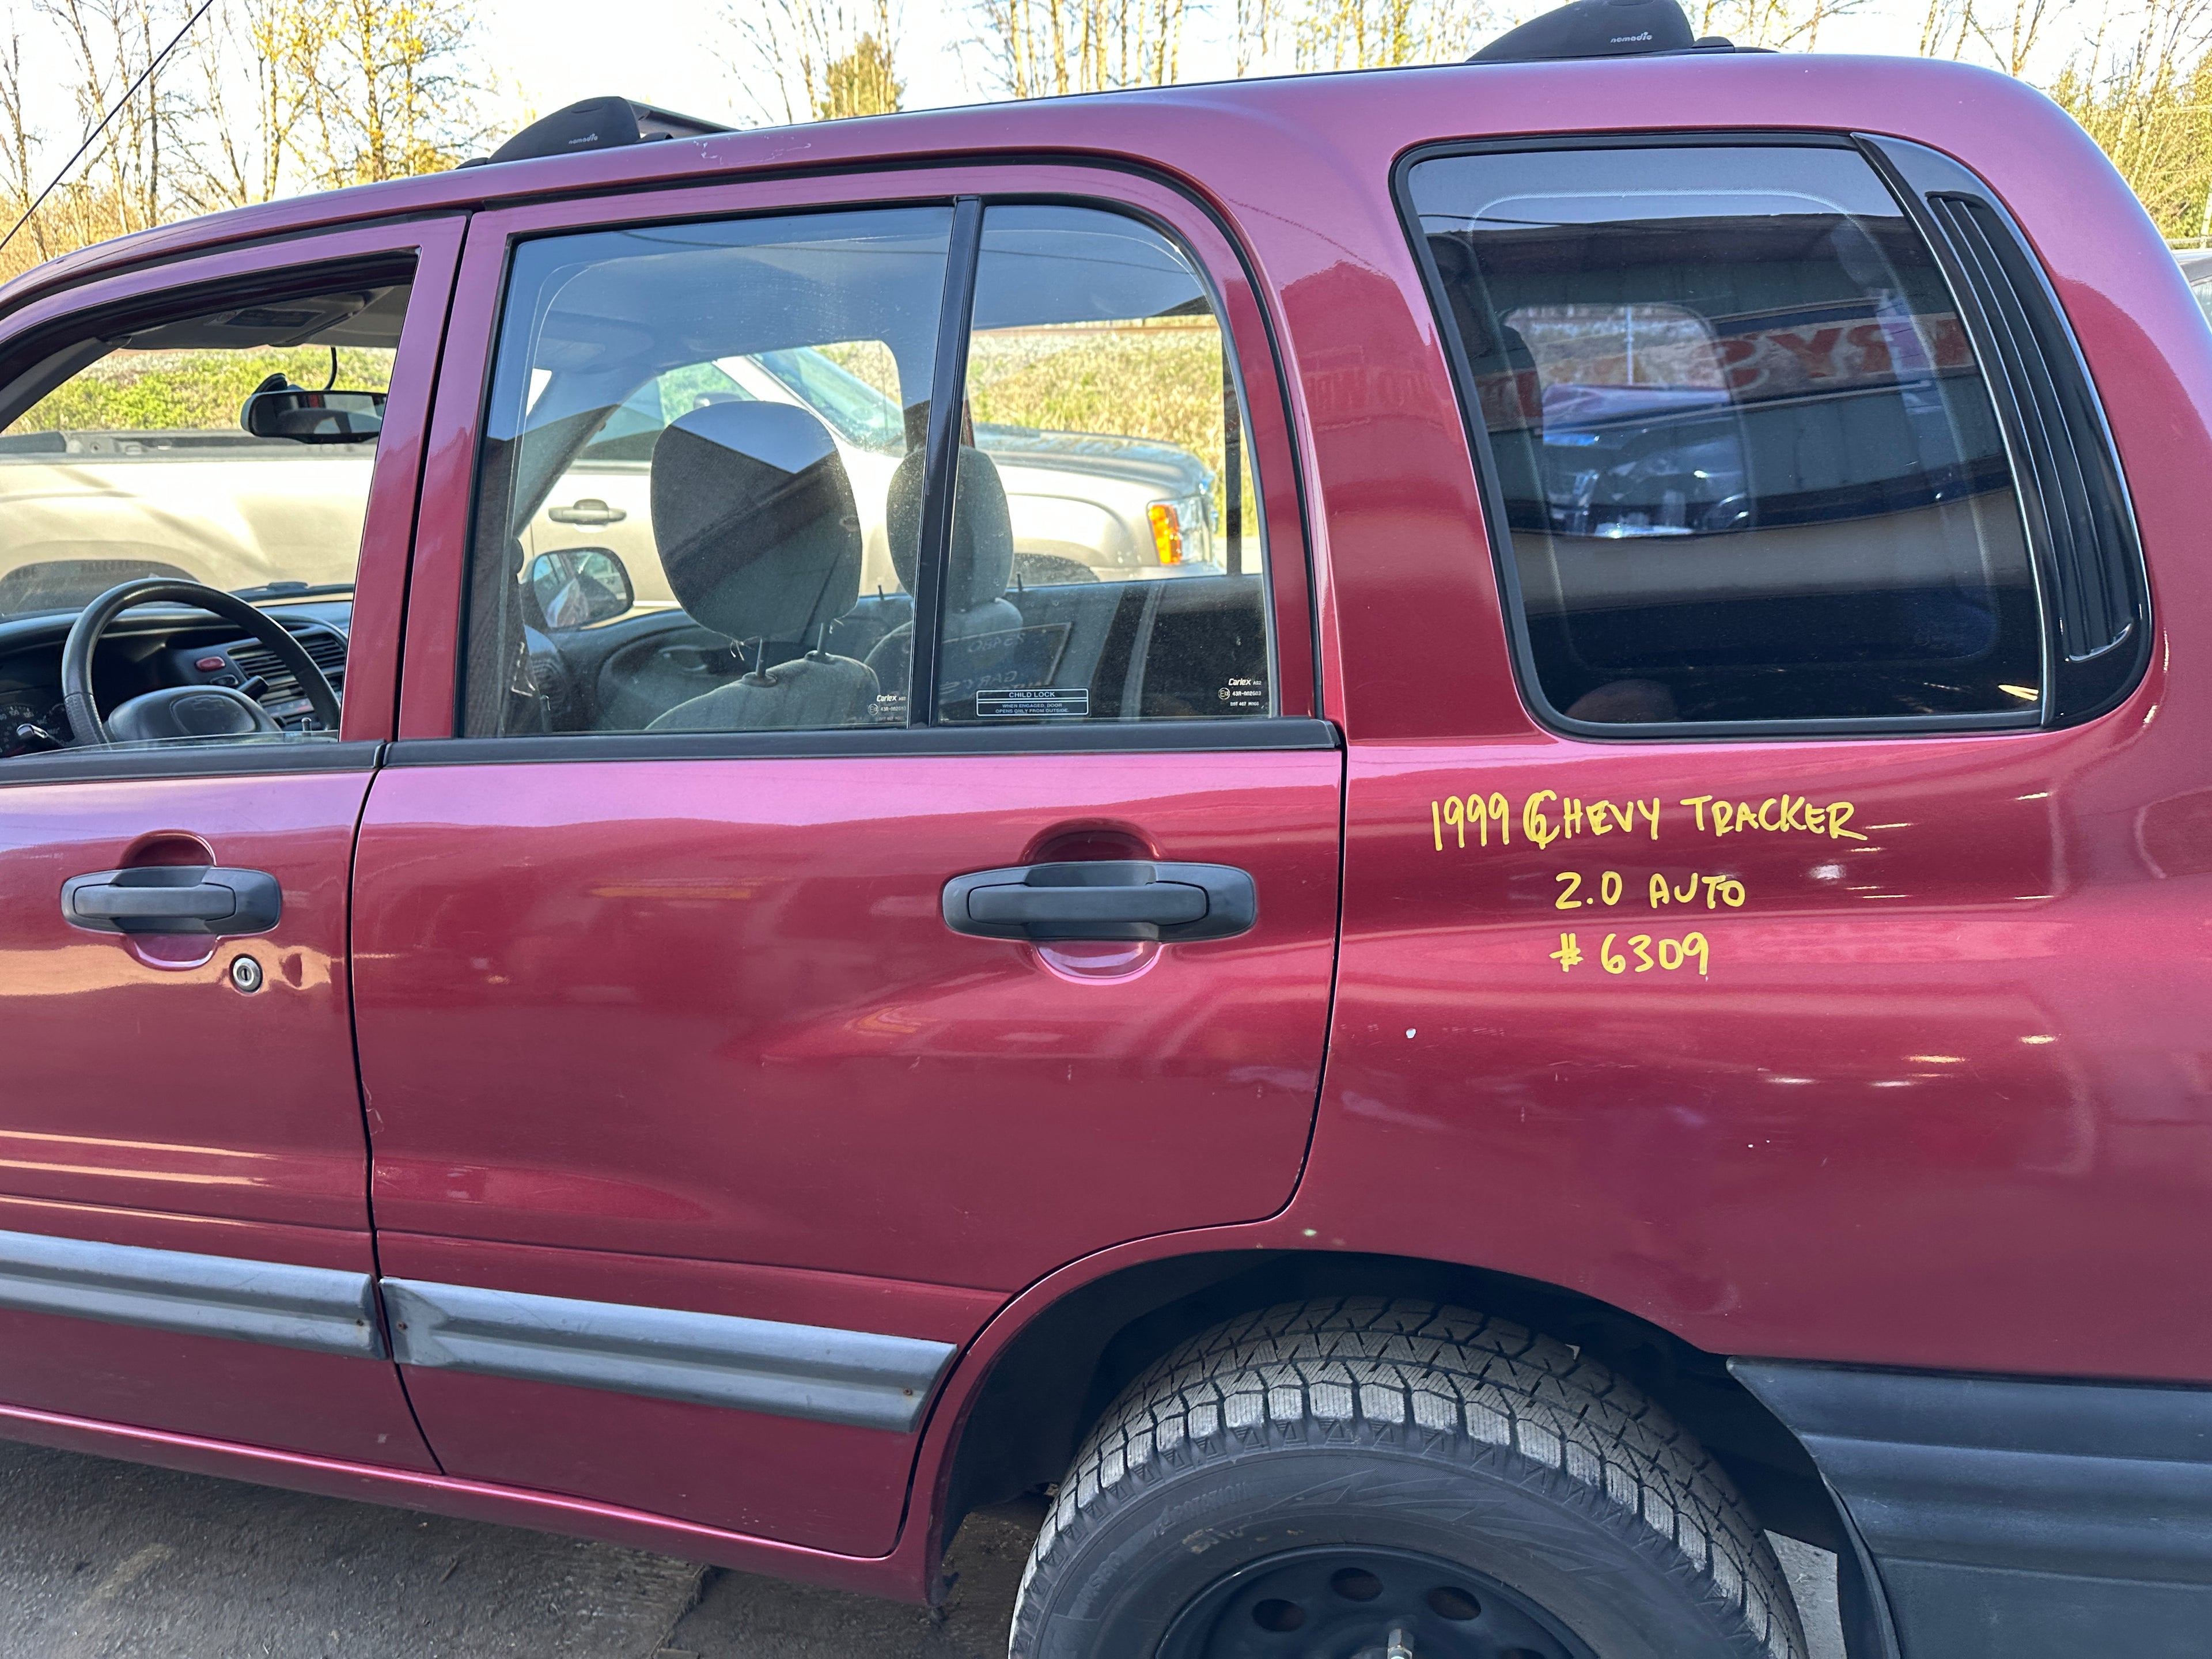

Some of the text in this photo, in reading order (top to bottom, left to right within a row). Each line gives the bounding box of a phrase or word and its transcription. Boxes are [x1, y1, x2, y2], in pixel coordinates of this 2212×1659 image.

[876, 694, 897, 702] Carlex
[1228, 678, 1251, 686] Carlex
[1431, 792, 1510, 851] 1999
[1680, 794, 1868, 840] TRACKER
[1555, 871, 1745, 910] 2.0 AUTO
[1550, 931, 1709, 975] # 6309
